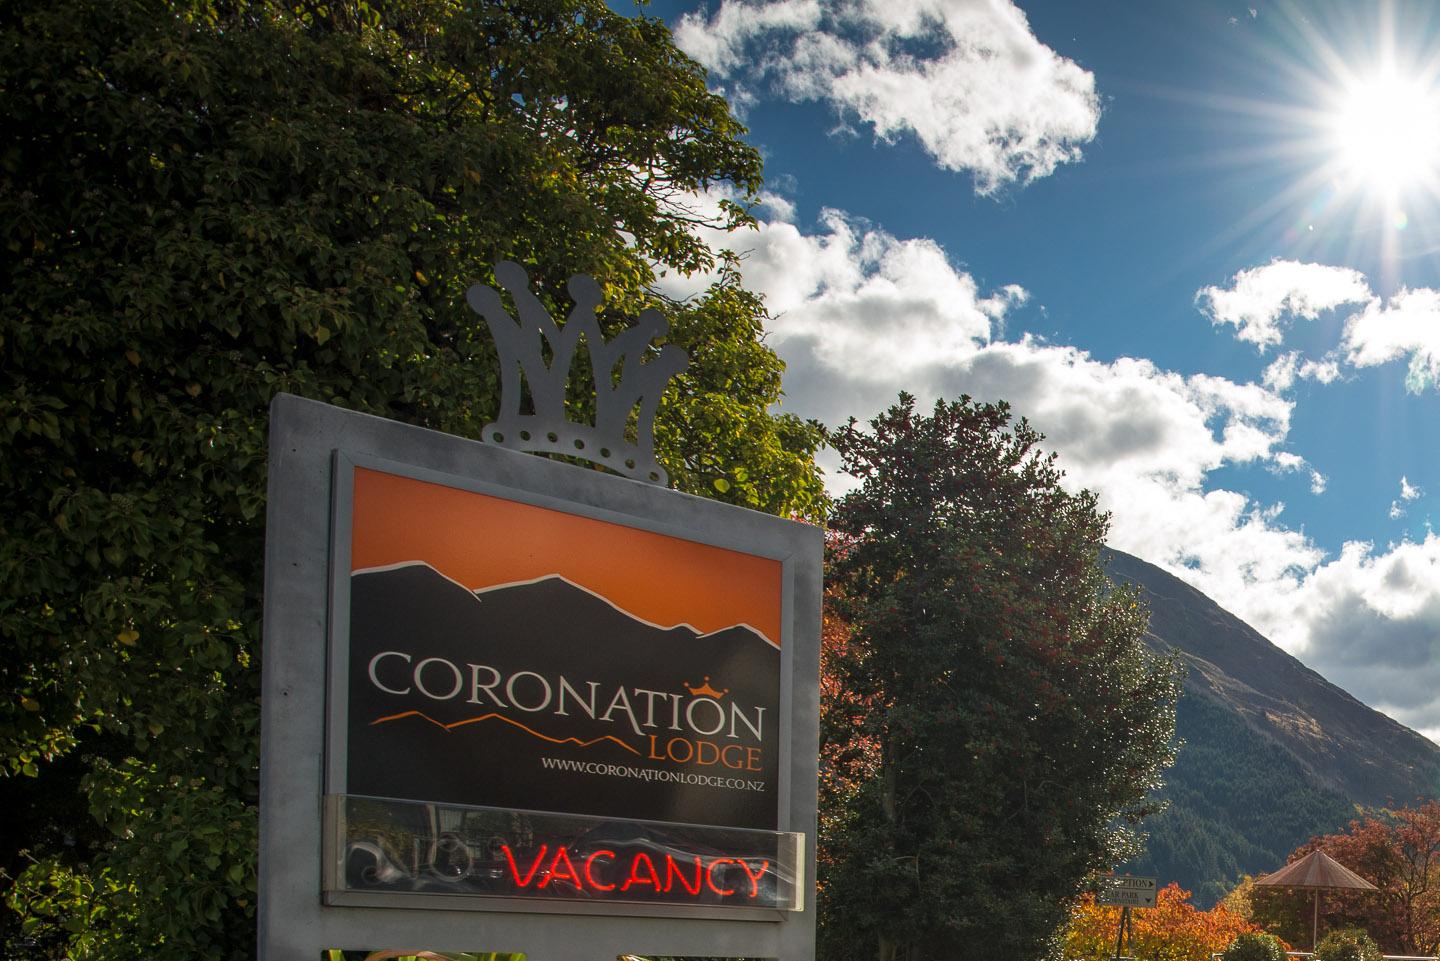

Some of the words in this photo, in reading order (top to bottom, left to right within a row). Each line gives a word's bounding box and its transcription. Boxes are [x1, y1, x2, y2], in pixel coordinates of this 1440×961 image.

[368, 650, 767, 742] CORONATION
[541, 757, 766, 792] WWW.CORONATIONLODGE.CO.NZ
[648, 734, 763, 772] LODGE
[501, 843, 770, 898] VACANCY
